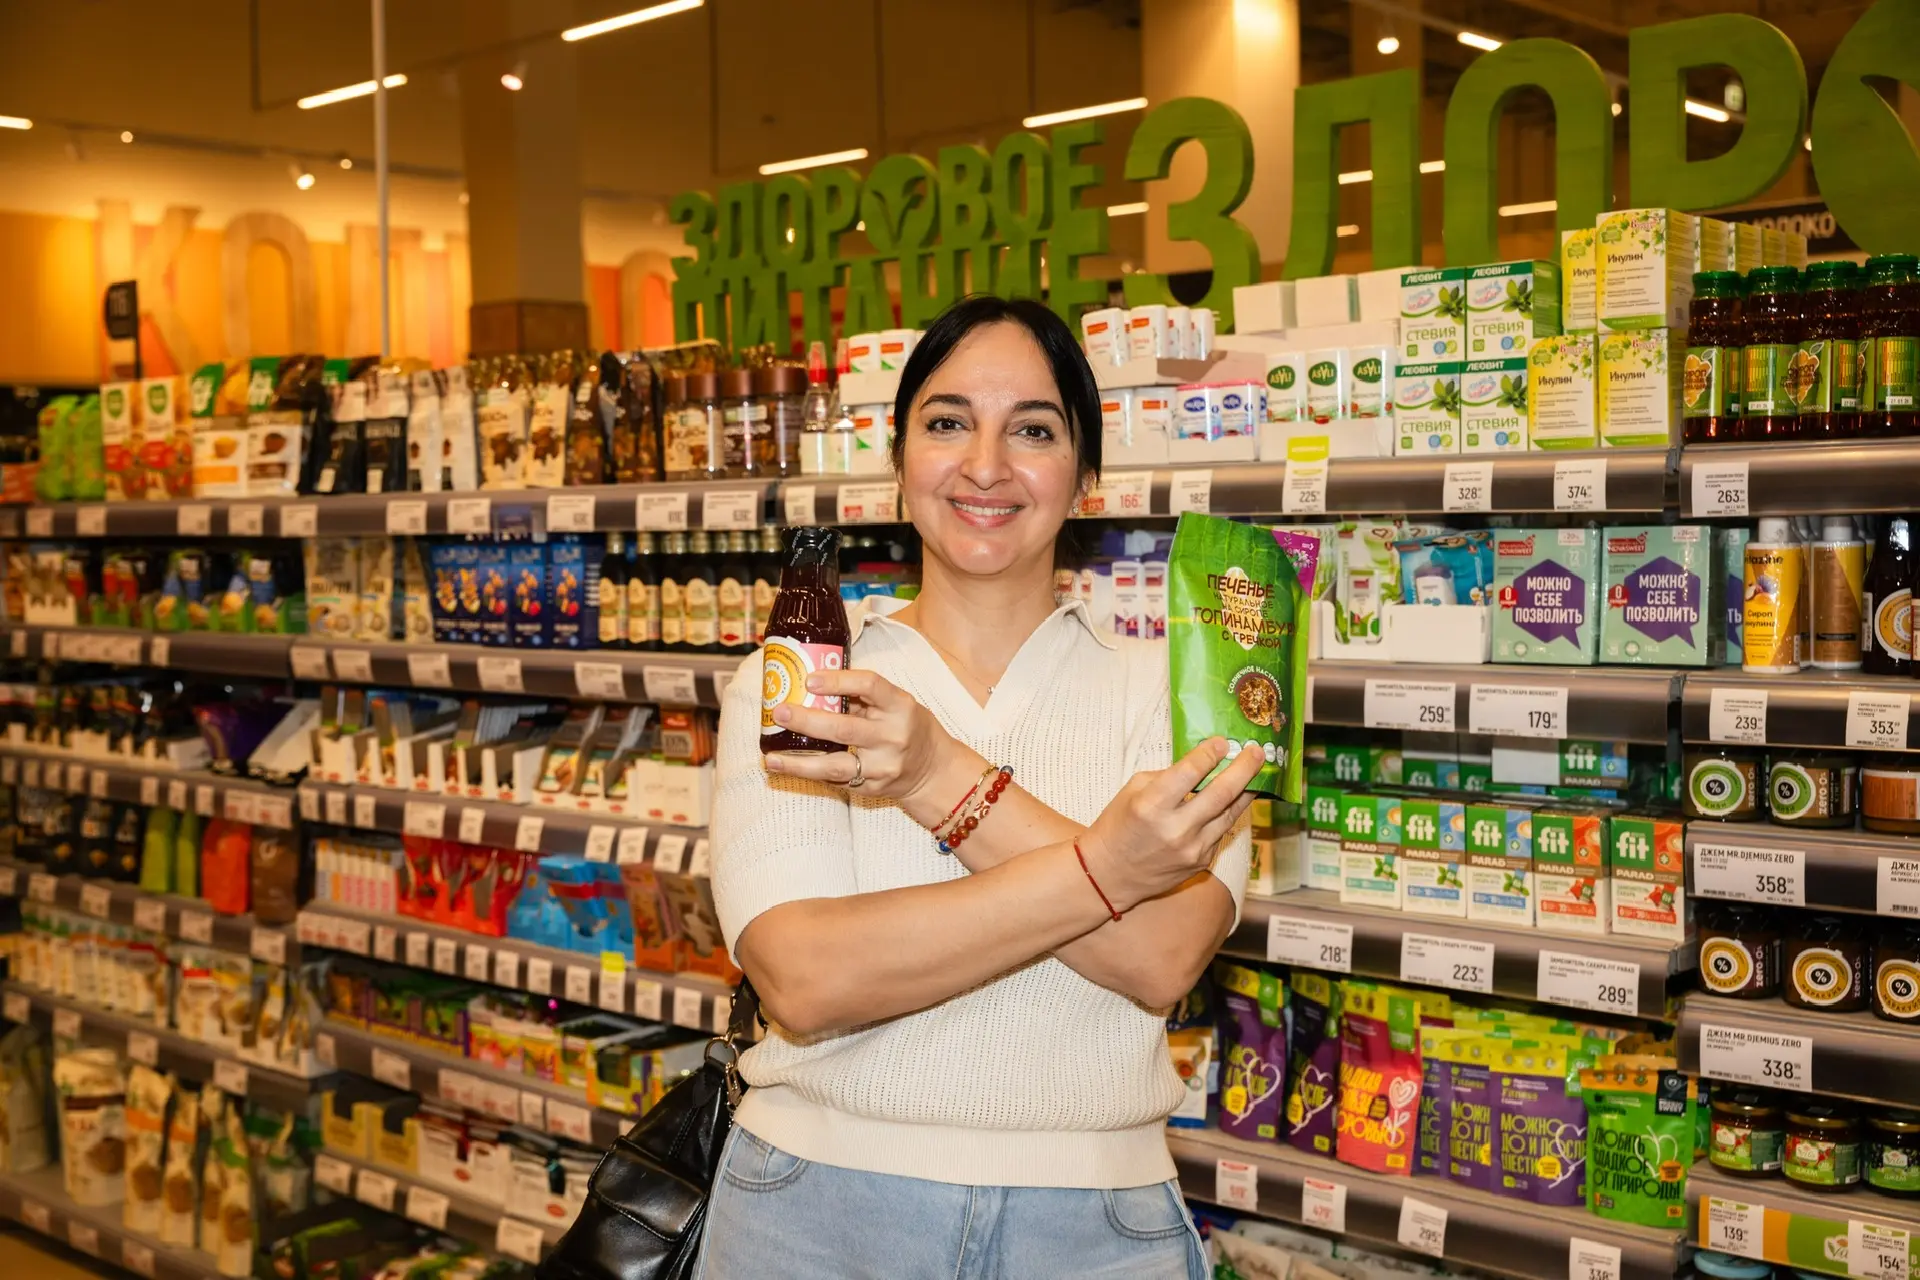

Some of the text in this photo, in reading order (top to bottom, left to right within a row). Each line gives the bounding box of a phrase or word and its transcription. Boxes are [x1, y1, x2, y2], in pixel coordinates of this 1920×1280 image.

[671, 120, 1106, 272] ЗДОРОВОЕ
[1608, 252, 1643, 264] Инулин
[1406, 271, 1443, 285] ЛЕОВИТ
[1472, 265, 1511, 278] ЛЕОВИТ
[1400, 364, 1438, 376] ЛЕОВИТ
[1466, 360, 1505, 372] ЛЕОВИТ
[1538, 375, 1573, 387] Инулин
[1610, 371, 1646, 383] Инулин
[1299, 491, 1317, 503] 225
[1458, 487, 1477, 500] 328
[1567, 485, 1587, 499] 374
[1717, 490, 1740, 504] 263
[1119, 494, 1138, 508] 166
[1207, 574, 1275, 599] ПЕЧЕНЬЕ
[1527, 577, 1571, 591] МОЖНО
[1639, 575, 1685, 588] МОЖНО
[1213, 591, 1274, 609] НАТУРАЛЬНОЕ
[1534, 592, 1563, 606] СЕБЕ
[1647, 591, 1676, 604] СЕБЕ
[1234, 606, 1268, 618] СИРОПЕ
[1515, 608, 1583, 624] ПОЗВОЛИТЬ
[1626, 606, 1698, 622] ПОЗВОЛИТЬ
[1748, 611, 1772, 620] Сироп
[1222, 630, 1229, 641] С
[1227, 665, 1255, 694] СОЛНЕЧНОЕ
[1420, 705, 1444, 723] 259
[1528, 711, 1551, 729] 179
[1735, 715, 1757, 730] 239
[1870, 720, 1894, 735] 353
[1565, 744, 1597, 770] fit
[1334, 753, 1362, 782] fit
[1818, 788, 1828, 816] zero
[1311, 796, 1338, 824] fit
[1345, 806, 1374, 834] fit
[1405, 813, 1436, 842] fit
[1471, 819, 1502, 848] fit
[1537, 826, 1570, 855] fit
[1344, 841, 1377, 853] PARAD
[1615, 831, 1650, 861] fit
[1405, 848, 1439, 861] PARAD
[1471, 854, 1506, 868] PARAD
[1700, 848, 1725, 857] ДЖЕМ
[1774, 854, 1795, 864] ZERO
[1538, 863, 1575, 875] PARAD
[1891, 861, 1919, 871] ДЖЕМ
[1615, 868, 1655, 881] PARAD
[1755, 874, 1787, 894] 358
[1321, 945, 1341, 962] 218
[1453, 964, 1478, 982] 223
[1756, 963, 1764, 988] zero
[1598, 984, 1625, 1005] 289
[1707, 1029, 1802, 1048] ДЖЕМ ZERO
[1762, 1058, 1794, 1079] 338
[1501, 1113, 1564, 1136] МОЖНО
[1502, 1134, 1525, 1153] ДО
[1529, 1138, 1537, 1154] И
[1419, 1227, 1437, 1242] 295
[1723, 1226, 1744, 1241] 139
[1878, 1255, 1900, 1271] 154
